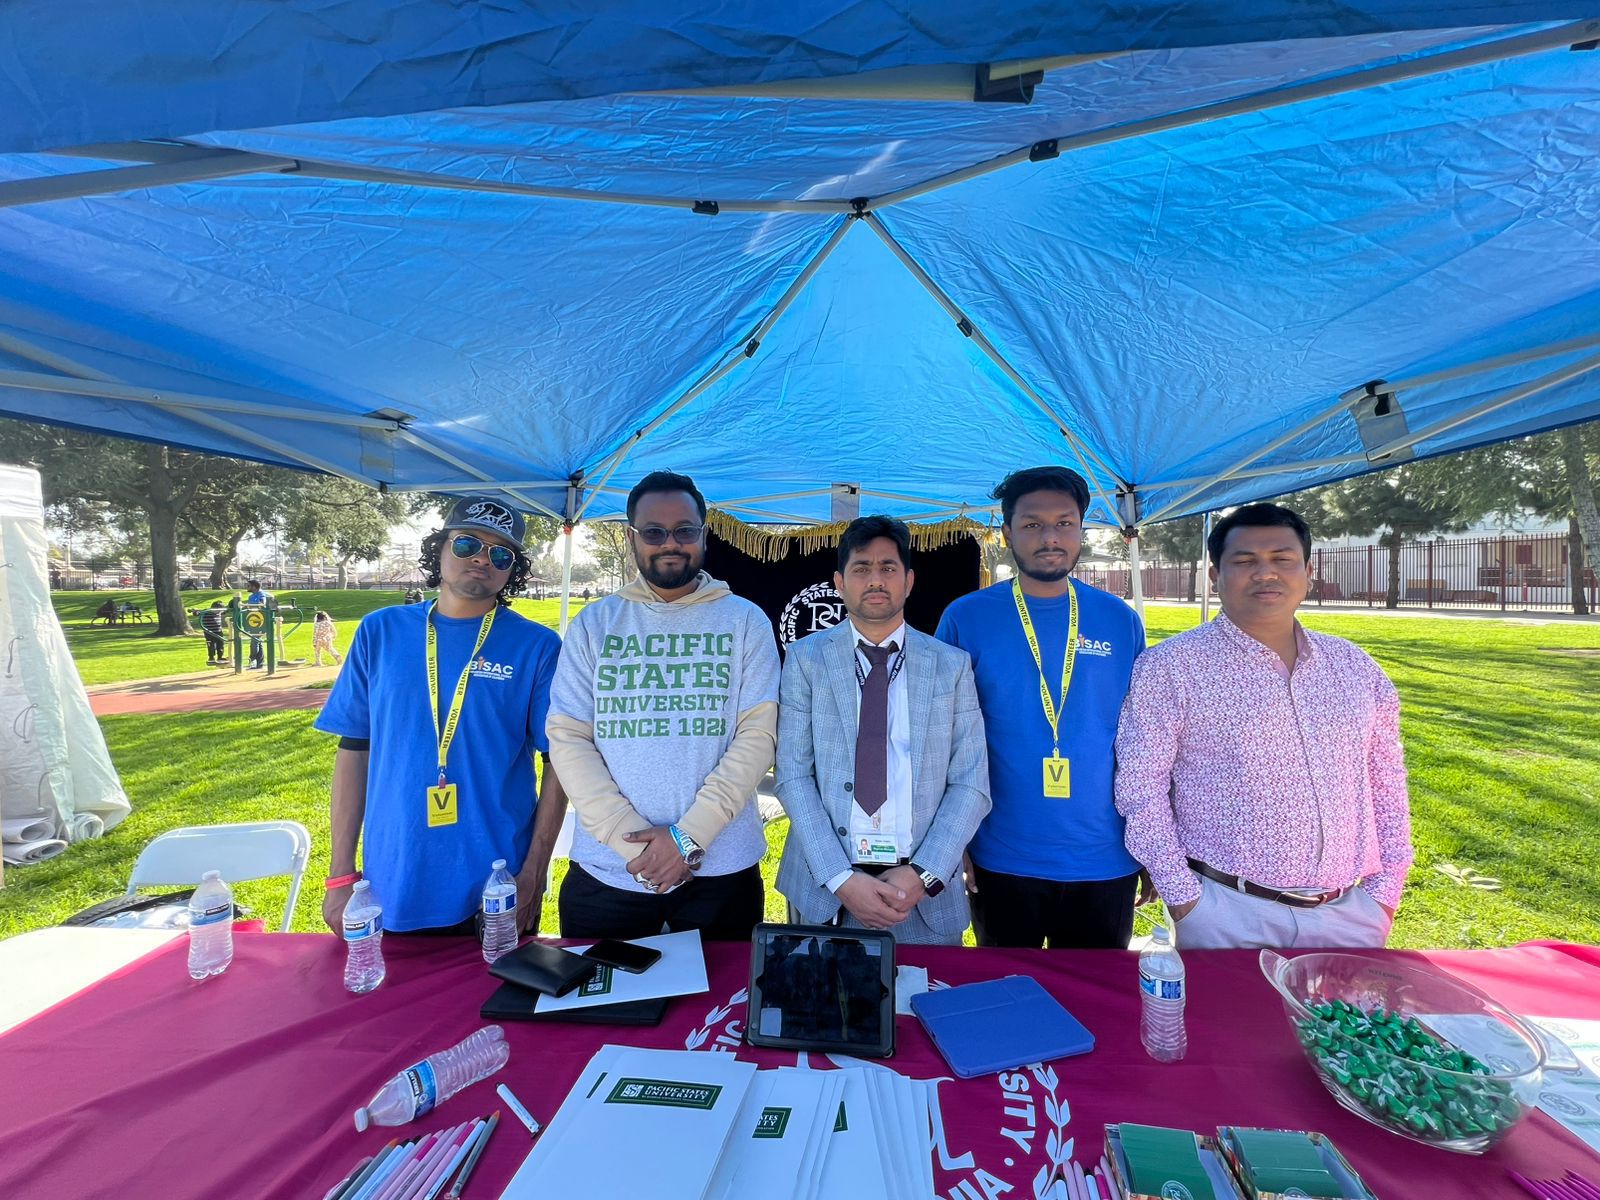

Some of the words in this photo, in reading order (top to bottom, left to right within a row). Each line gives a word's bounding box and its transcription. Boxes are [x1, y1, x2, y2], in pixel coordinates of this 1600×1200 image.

[787, 607, 800, 642] ACIFIC
[1015, 593, 1030, 626] VOLUNTEER
[477, 613, 493, 648] VOLUNTEER
[600, 632, 734, 660] PACIFIC
[1065, 638, 1076, 675] VOLUNTEER
[428, 656, 437, 696] VOLUNTEER
[597, 662, 731, 691] STATES
[596, 694, 729, 714] UNIVERSITY
[1041, 683, 1054, 722] VOLUNTEER
[442, 708, 459, 749] VOLUNTEER
[597, 718, 670, 739] SINCE
[1048, 765, 1065, 783] V
[433, 791, 451, 811] V
[644, 1090, 708, 1101] UNIVERSITY
[646, 1085, 680, 1094] PACIFIC
[680, 1088, 710, 1096] STATES
[998, 1072, 1036, 1155] SITY
